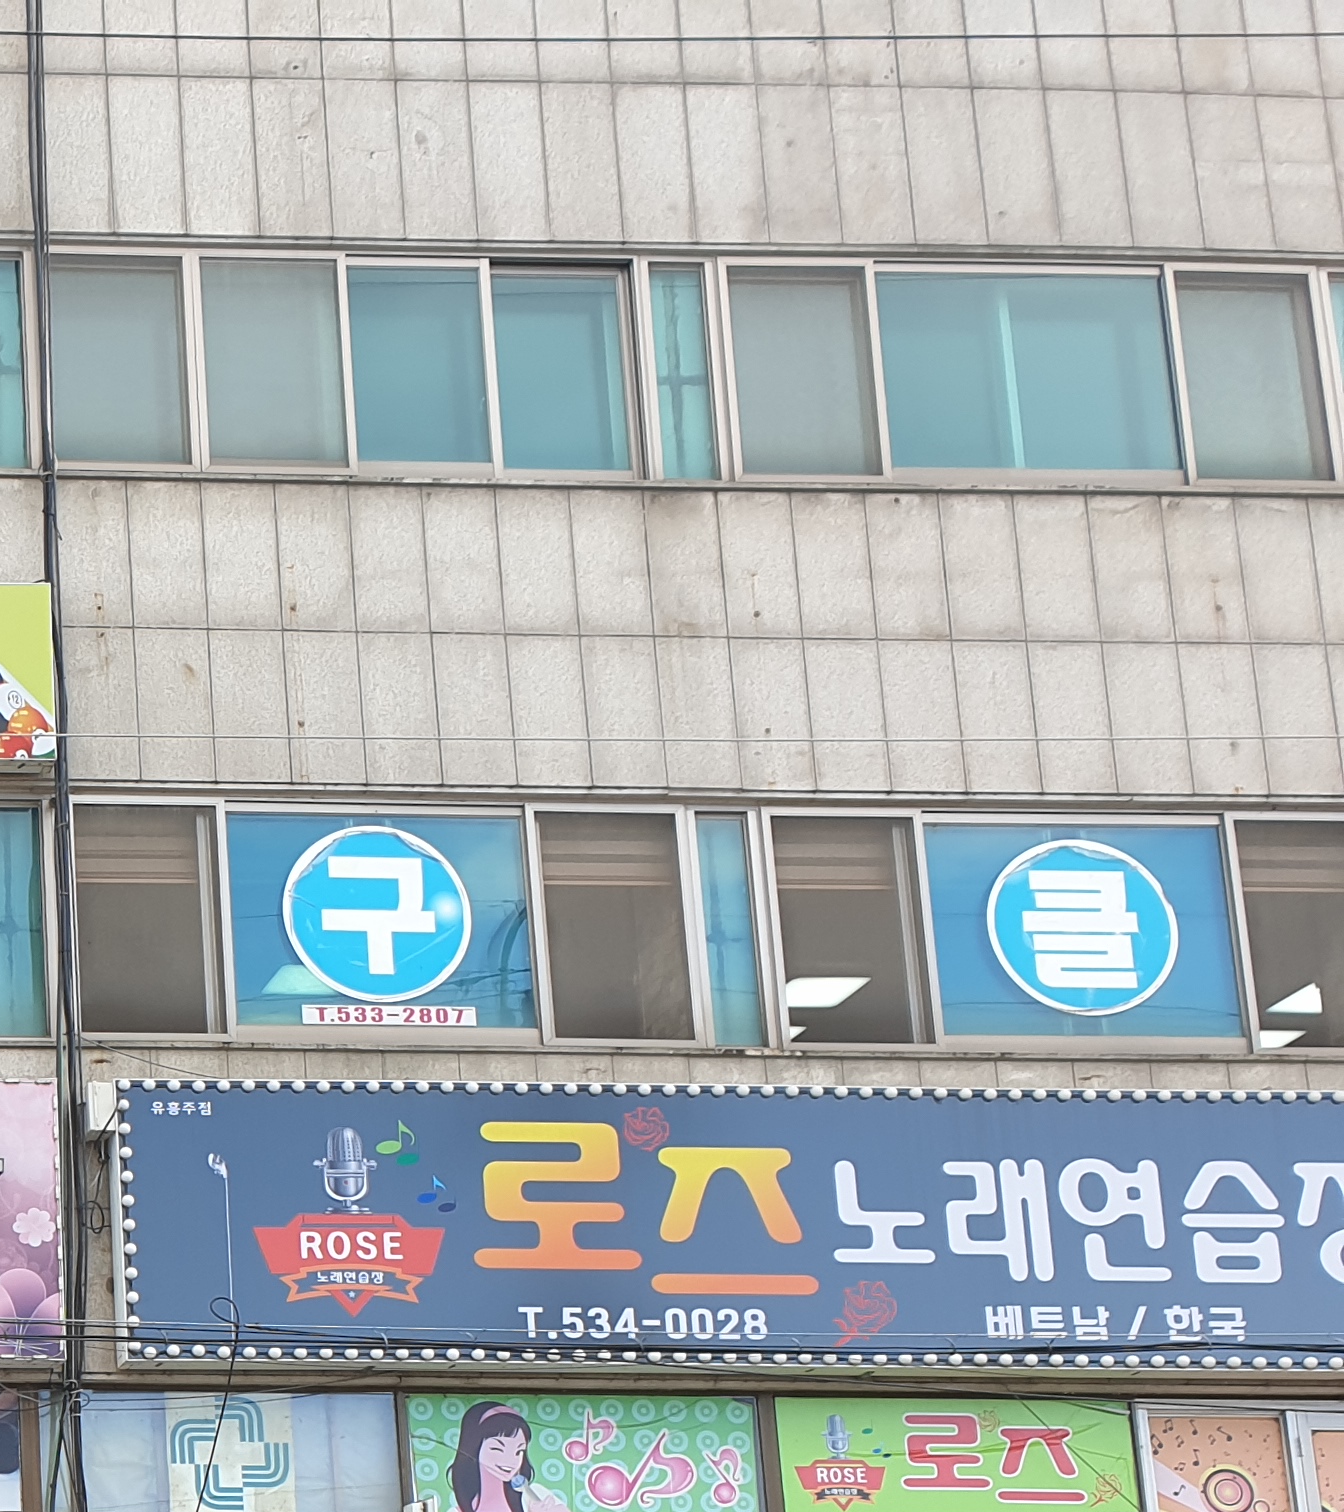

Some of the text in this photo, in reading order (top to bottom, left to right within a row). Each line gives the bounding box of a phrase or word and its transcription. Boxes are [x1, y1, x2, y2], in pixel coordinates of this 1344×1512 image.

[322, 856, 436, 975] 구
[1021, 869, 1139, 990] 클
[315, 1006, 466, 1024] T.533-2807
[150, 1100, 212, 1117] 유흥주점
[473, 1121, 820, 1295] 로즈
[299, 1231, 404, 1261] ROSE
[316, 1271, 384, 1284] 노래연습장
[518, 1306, 768, 1341] T.534-0028
[985, 1305, 1110, 1342] 베트남
[1163, 1305, 1247, 1342] 한국
[816, 1467, 868, 1483] ROSE
[901, 1412, 1089, 1505] 로즈
